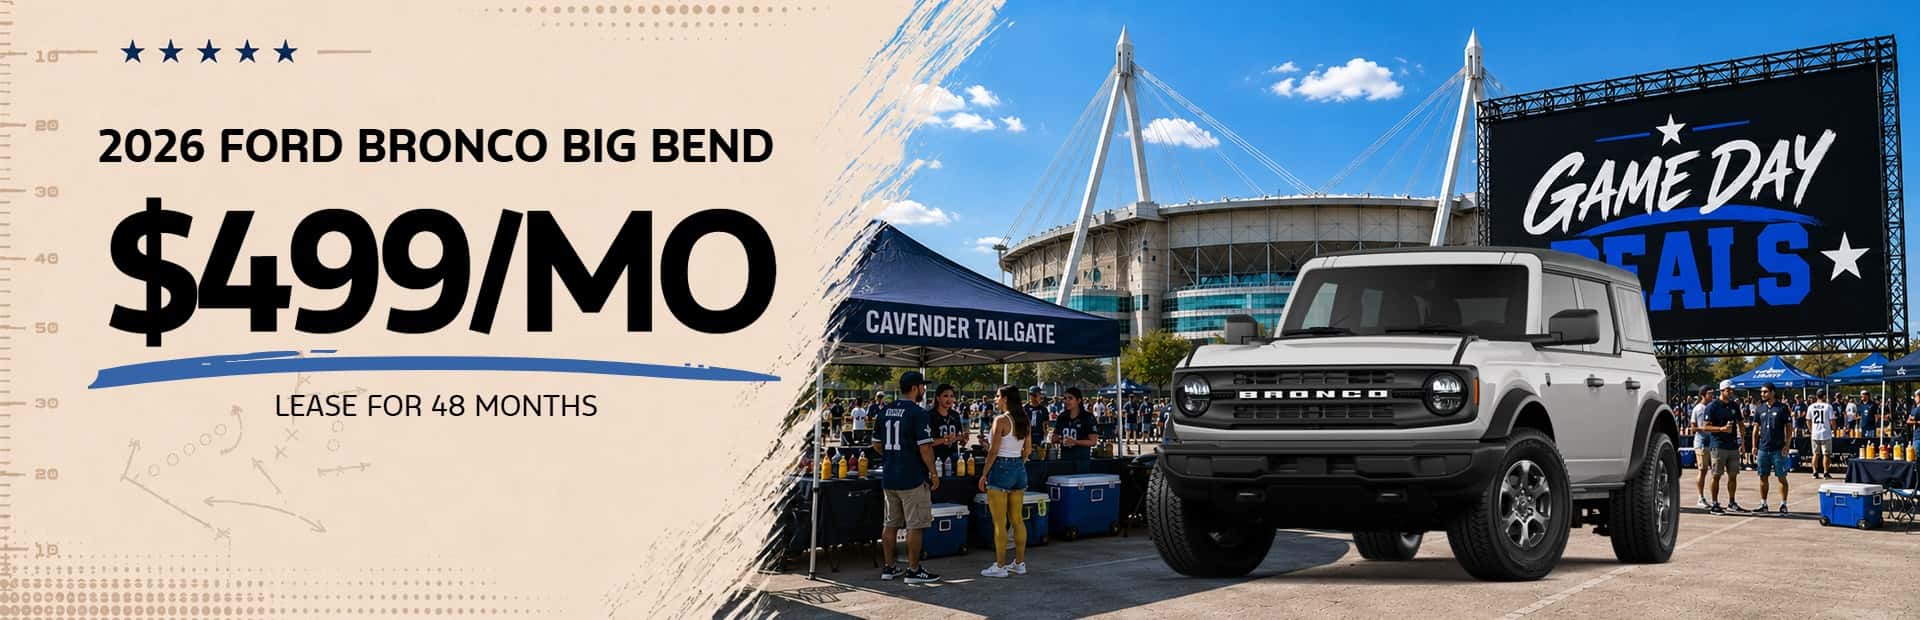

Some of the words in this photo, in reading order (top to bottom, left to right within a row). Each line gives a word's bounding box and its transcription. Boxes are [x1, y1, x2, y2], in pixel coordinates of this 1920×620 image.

[1523, 149, 1700, 236] GAME
[1699, 129, 1836, 215] DAY
[1550, 222, 1811, 312] EALS
[865, 309, 970, 340] CAVENDER
[975, 318, 1056, 345] TAILGATE
[1239, 390, 1388, 399] BRONCO
[884, 420, 902, 451] 11
